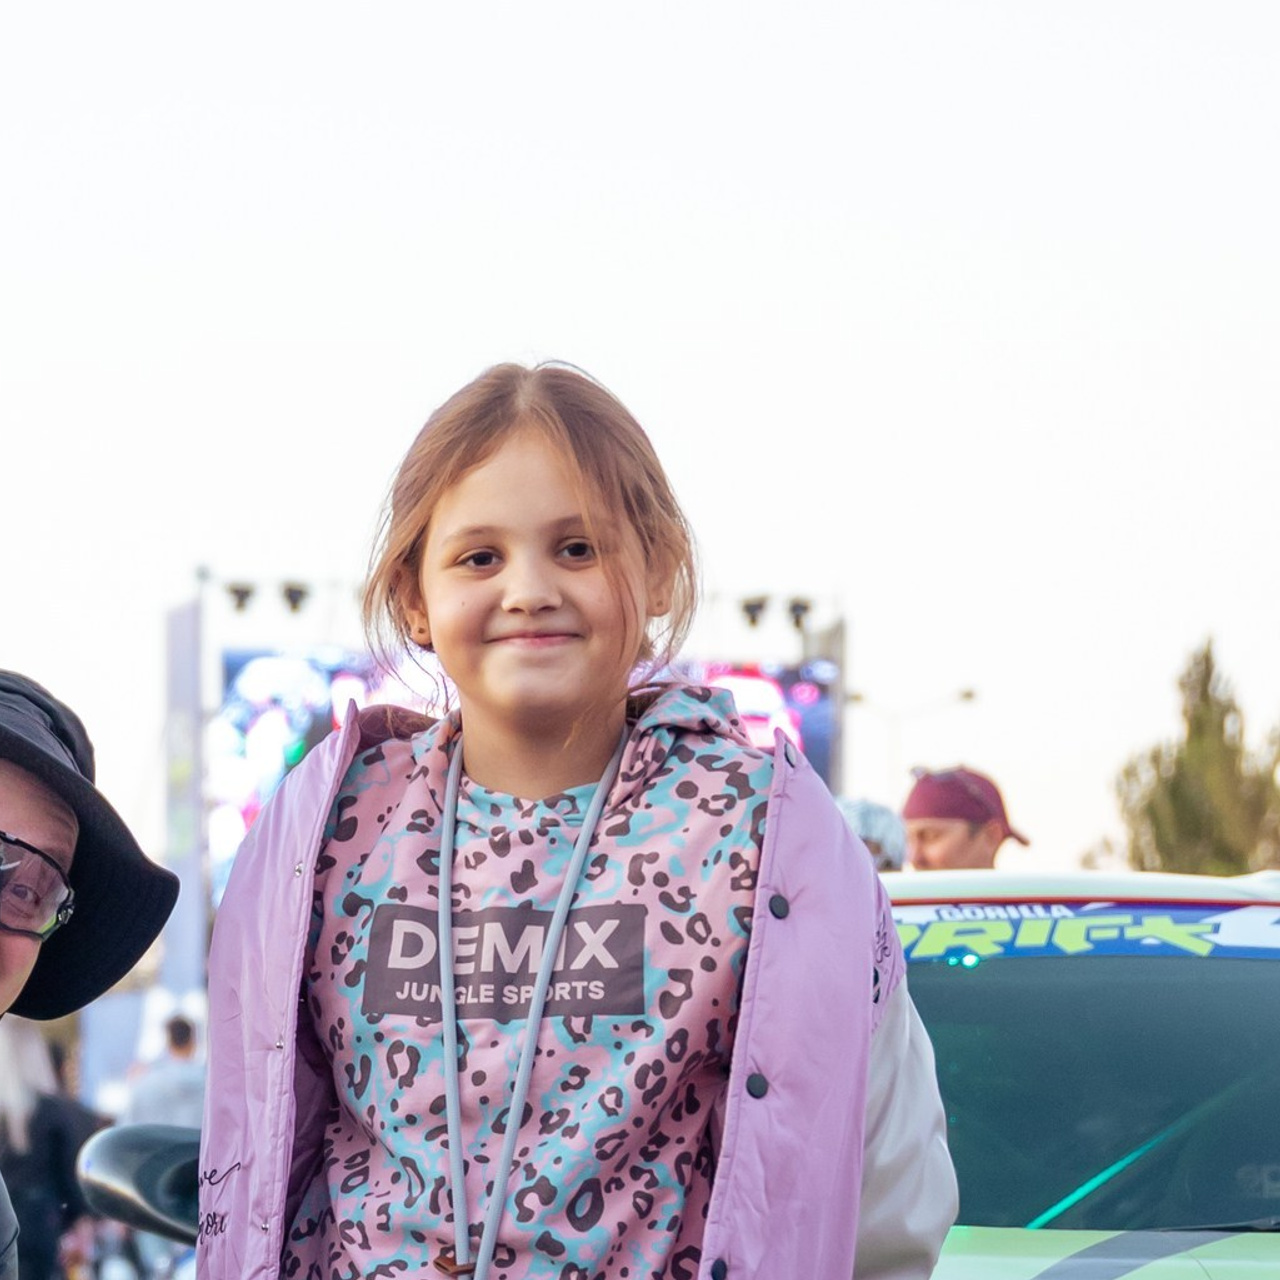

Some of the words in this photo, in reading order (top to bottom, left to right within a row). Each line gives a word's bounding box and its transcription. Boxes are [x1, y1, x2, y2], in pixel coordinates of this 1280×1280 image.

[937, 903, 1075, 921] GORILLA
[387, 919, 619, 975] DEMIX
[896, 914, 1215, 958] RIFT
[396, 980, 495, 1004] JUNGLE
[502, 980, 605, 1004] SPORTS
